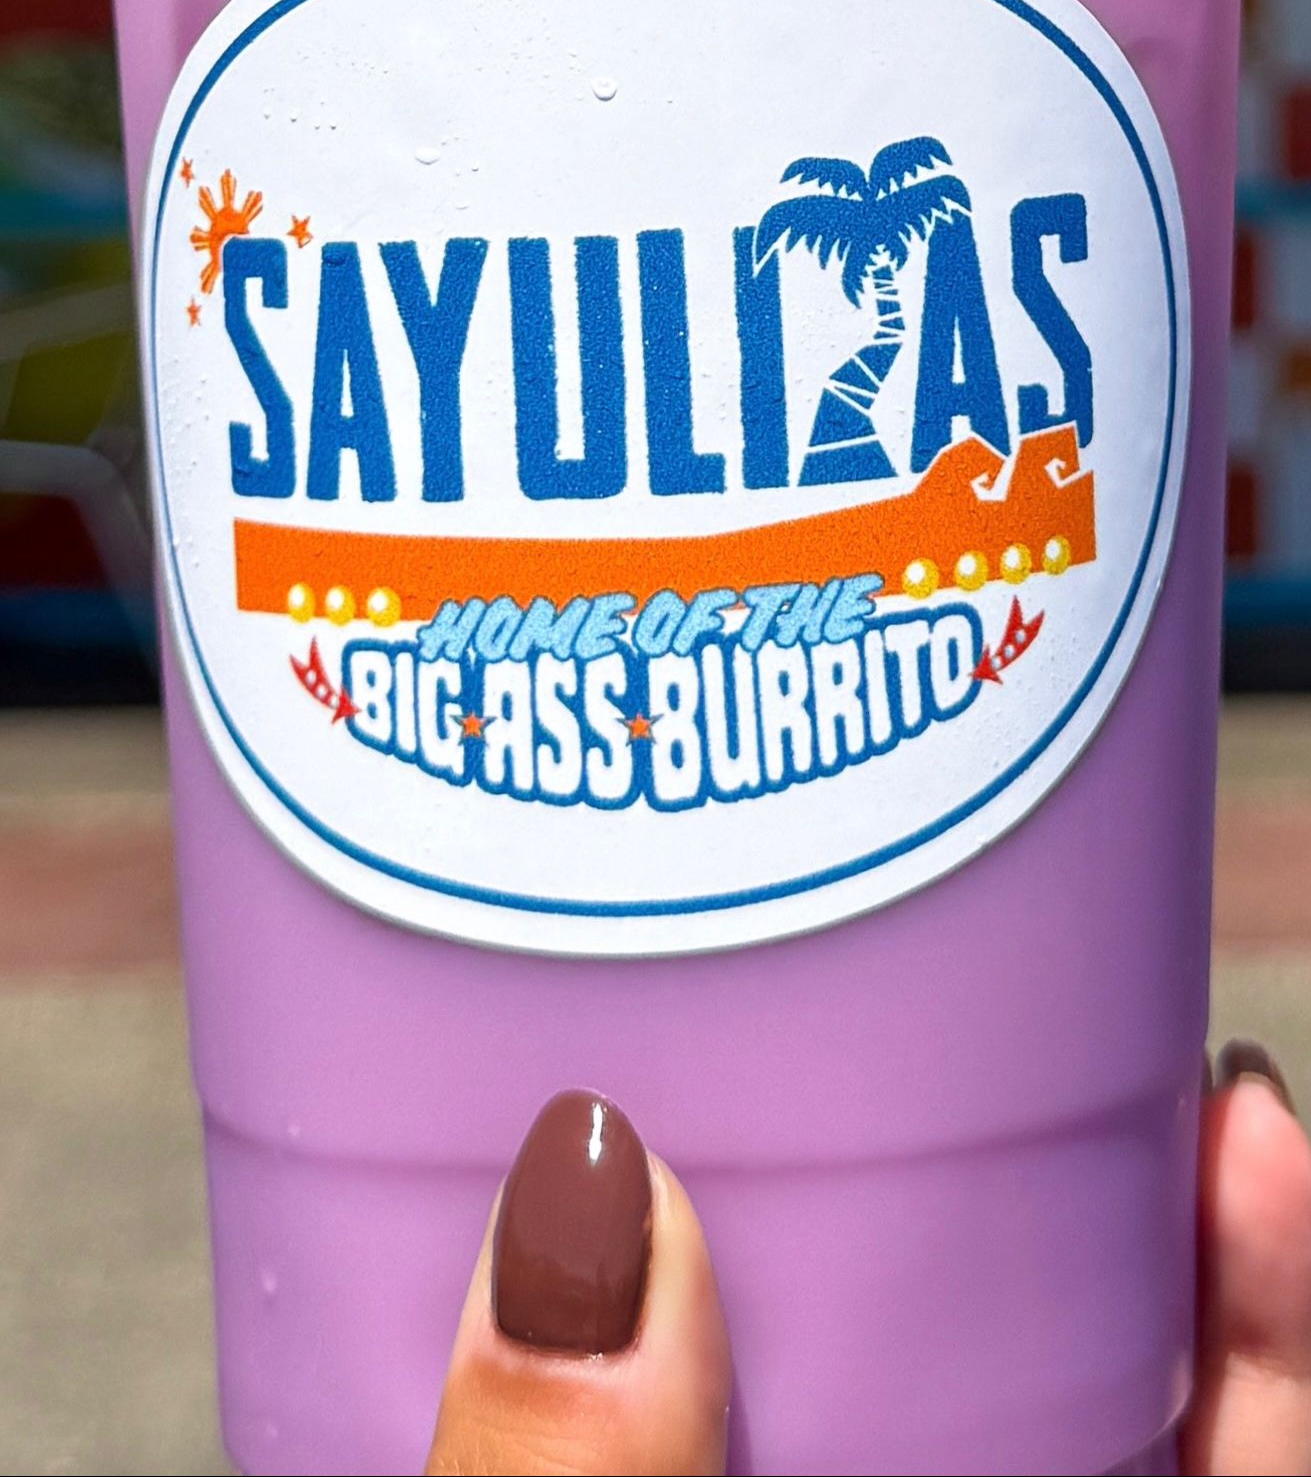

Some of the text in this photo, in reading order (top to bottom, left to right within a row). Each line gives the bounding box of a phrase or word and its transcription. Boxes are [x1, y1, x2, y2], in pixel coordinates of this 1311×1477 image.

[223, 135, 1094, 503] SAYULITAS
[344, 608, 982, 811] BIG ASS BURRITO
[417, 572, 885, 663] HOME OF THE
